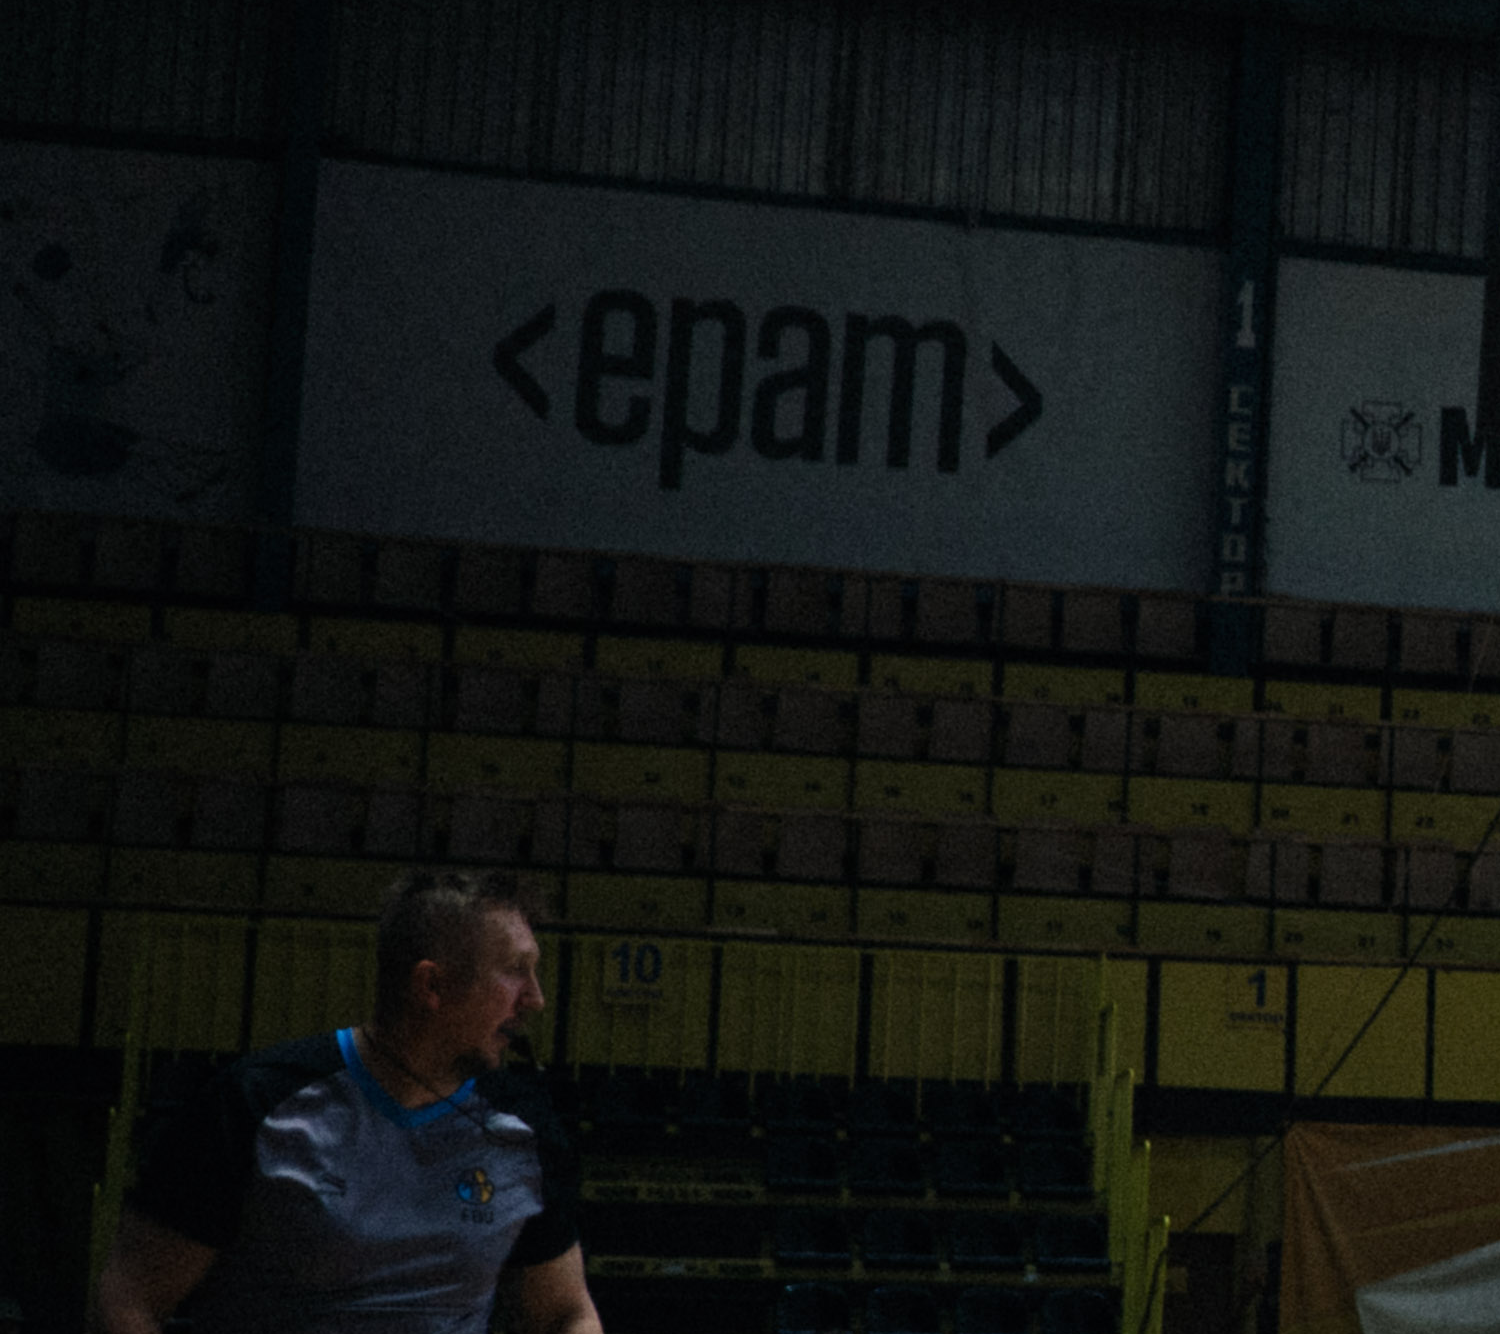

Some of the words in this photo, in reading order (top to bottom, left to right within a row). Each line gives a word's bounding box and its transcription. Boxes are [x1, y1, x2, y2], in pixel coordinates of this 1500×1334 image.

[1235, 280, 1256, 347] 1
[1220, 383, 1253, 595] СЕКТОР
[611, 941, 662, 984] 10
[1247, 969, 1265, 1007] 1
